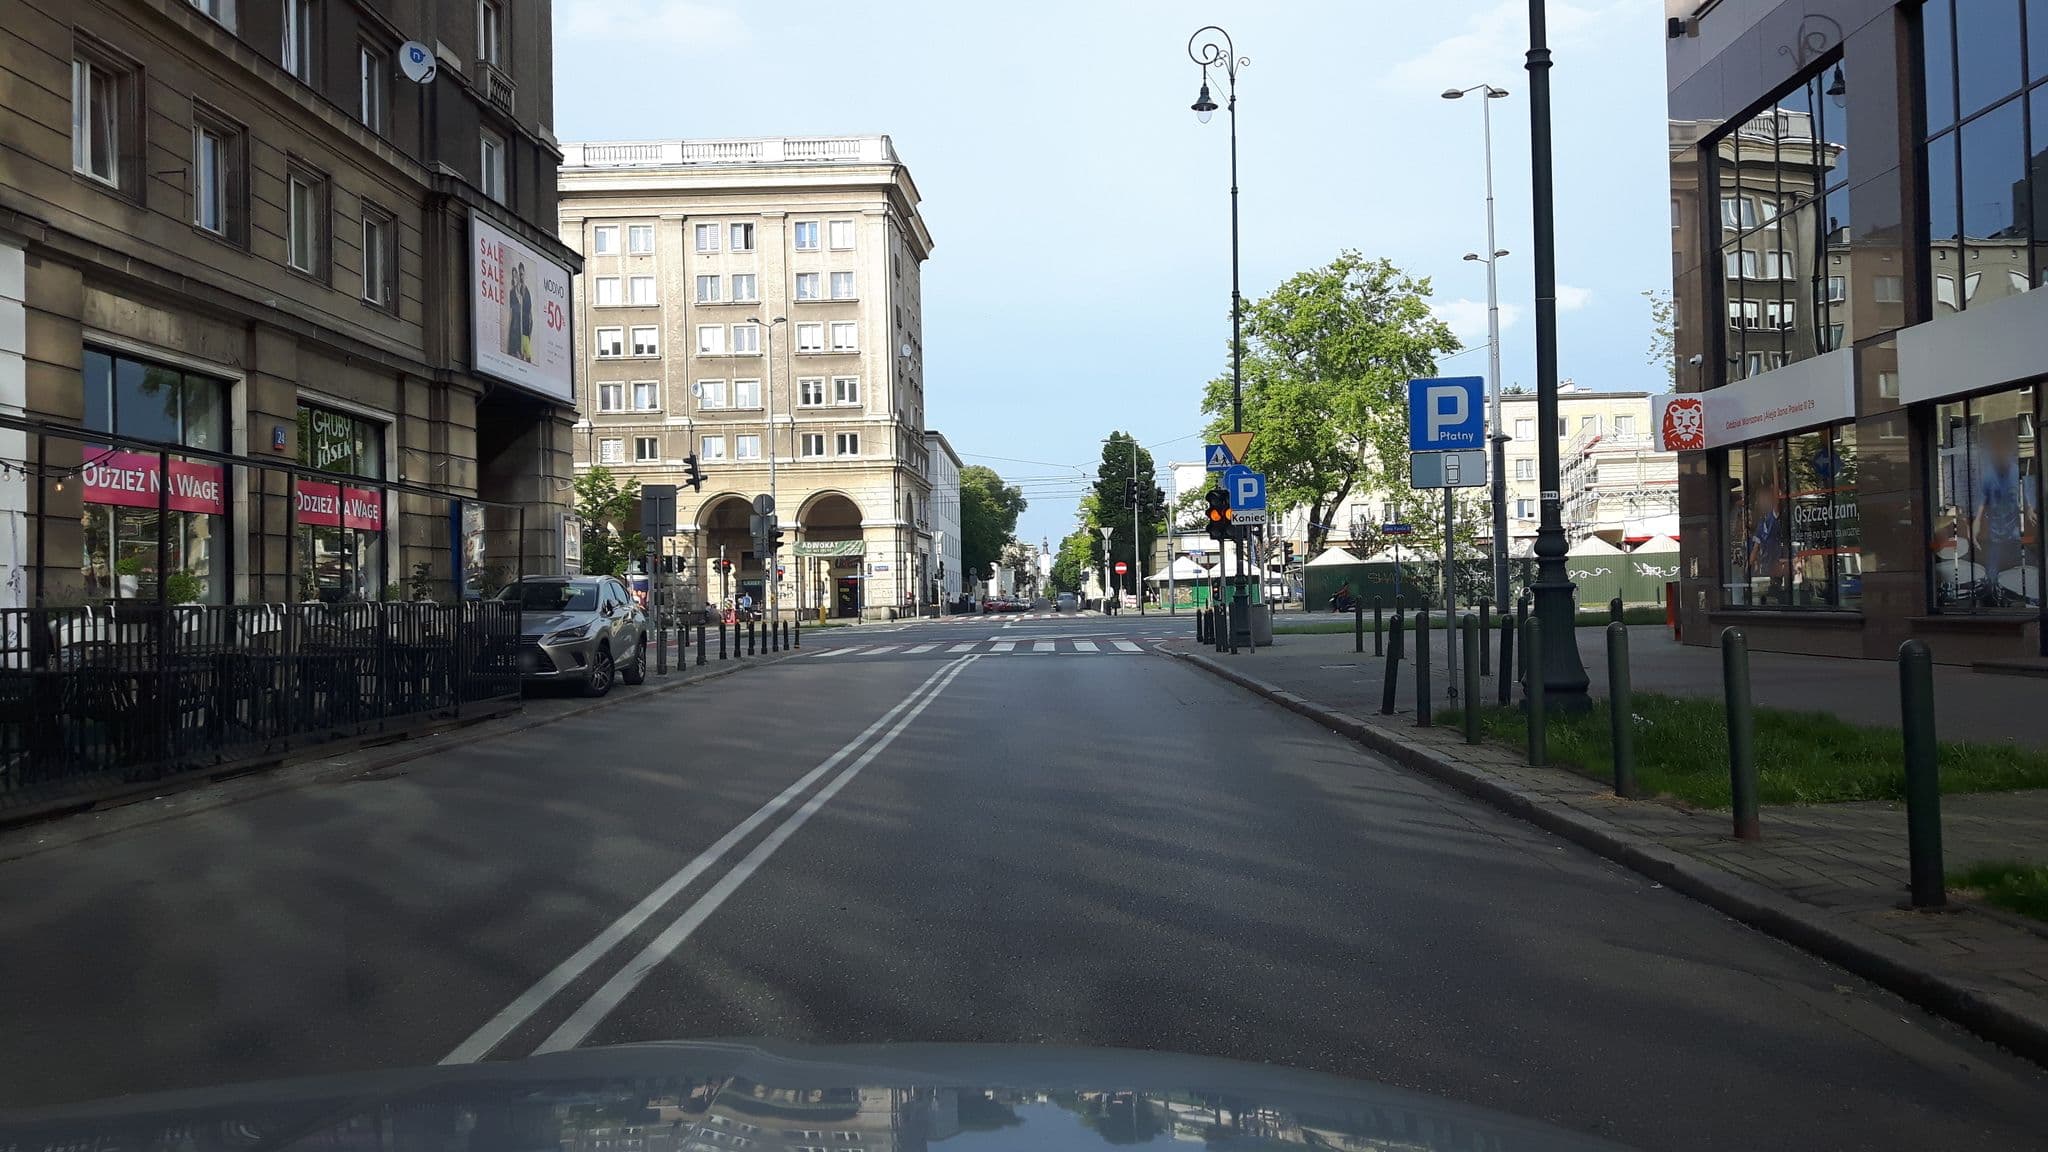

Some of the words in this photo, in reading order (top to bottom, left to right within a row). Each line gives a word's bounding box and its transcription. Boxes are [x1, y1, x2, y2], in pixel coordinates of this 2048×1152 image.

[480, 238, 504, 265] SALE
[480, 261, 504, 285] SALE
[481, 281, 505, 305] SALE
[543, 277, 565, 299] MODIVO
[313, 409, 352, 440] GRUBY
[1427, 386, 1468, 441] P
[277, 431, 285, 444] 24
[1440, 431, 1474, 443] Płatny
[176, 474, 219, 505] WAGĘ
[351, 499, 378, 523] WAGĘ
[1232, 513, 1265, 523] Koniec
[1794, 500, 1860, 525] Oszczędzam,
[802, 541, 838, 549] ADWOKAT
